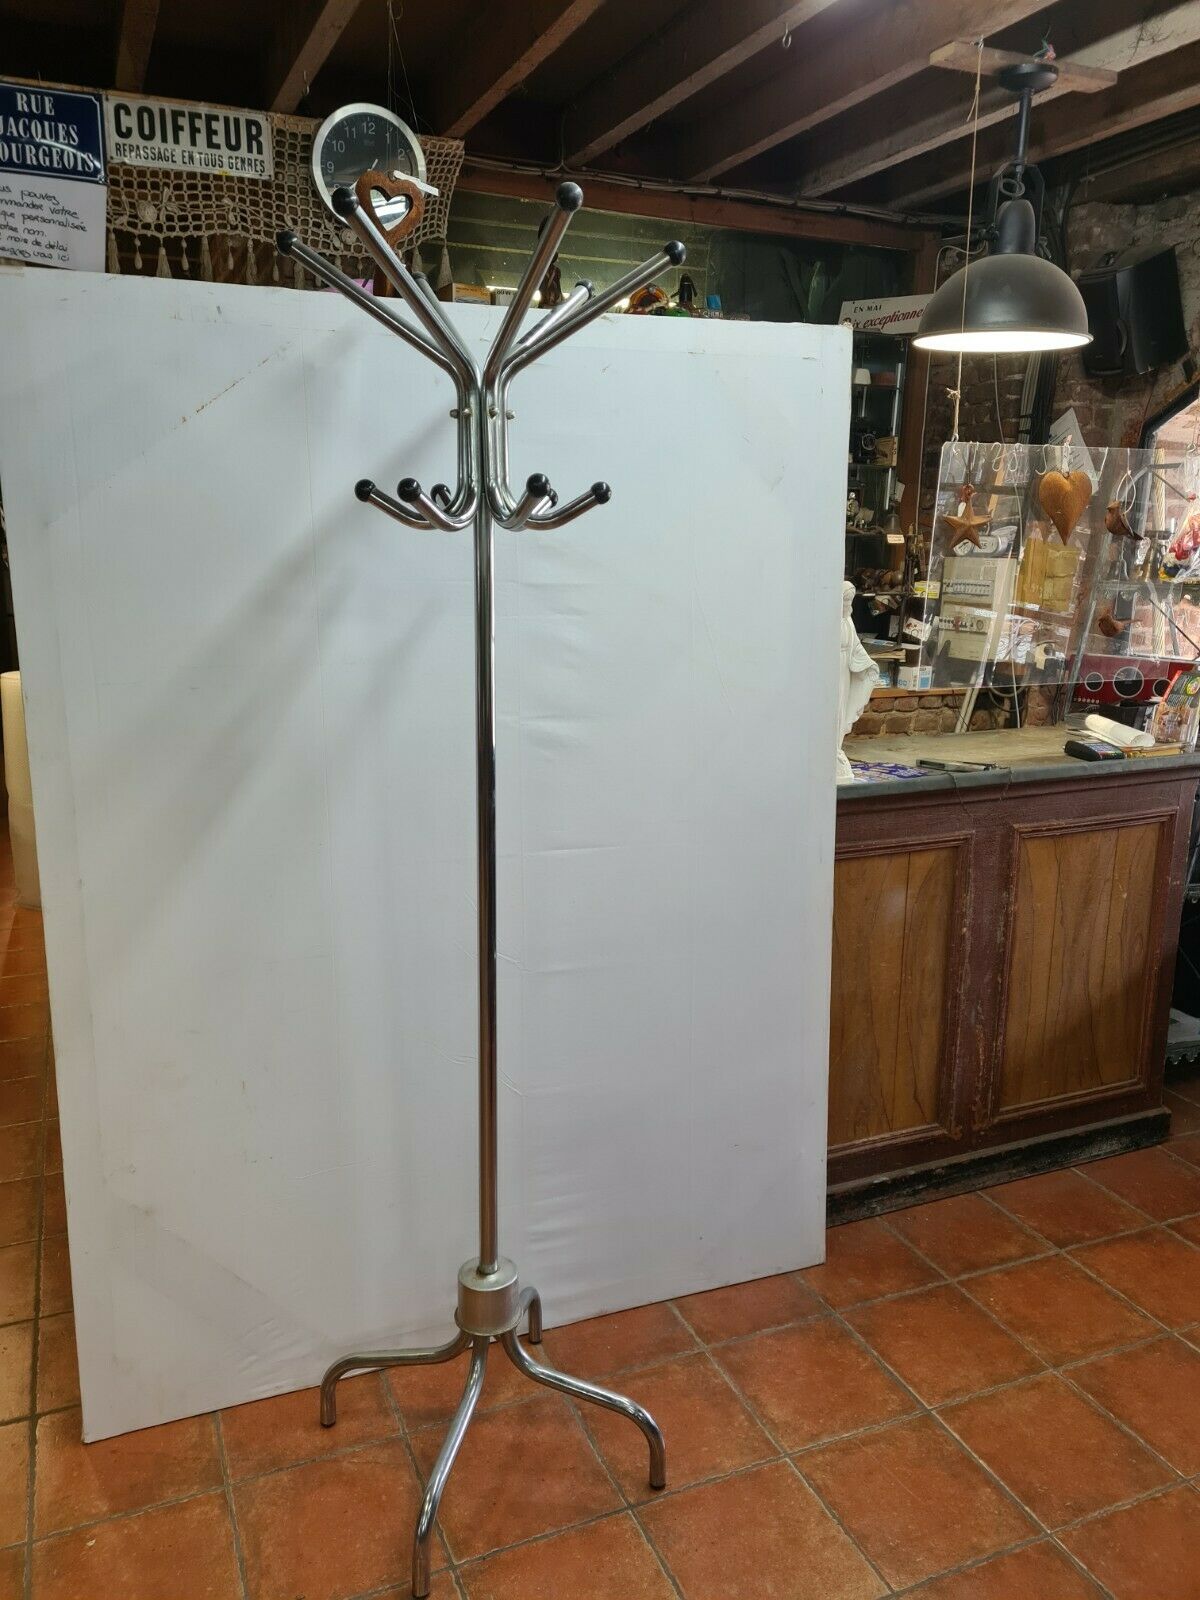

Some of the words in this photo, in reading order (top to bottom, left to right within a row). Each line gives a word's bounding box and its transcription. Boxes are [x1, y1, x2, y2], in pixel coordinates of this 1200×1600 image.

[16, 92, 55, 116] RUE
[114, 102, 264, 156] COIFFEUR
[344, 126, 357, 139] 11
[361, 121, 376, 135] 12
[331, 140, 346, 153] 10
[115, 142, 177, 164] REPASSAGE
[182, 149, 195, 166] EN
[199, 151, 224, 169] TOUS
[227, 155, 266, 174] GENRES
[326, 161, 335, 174] 9
[863, 308, 924, 330] exceptionne
